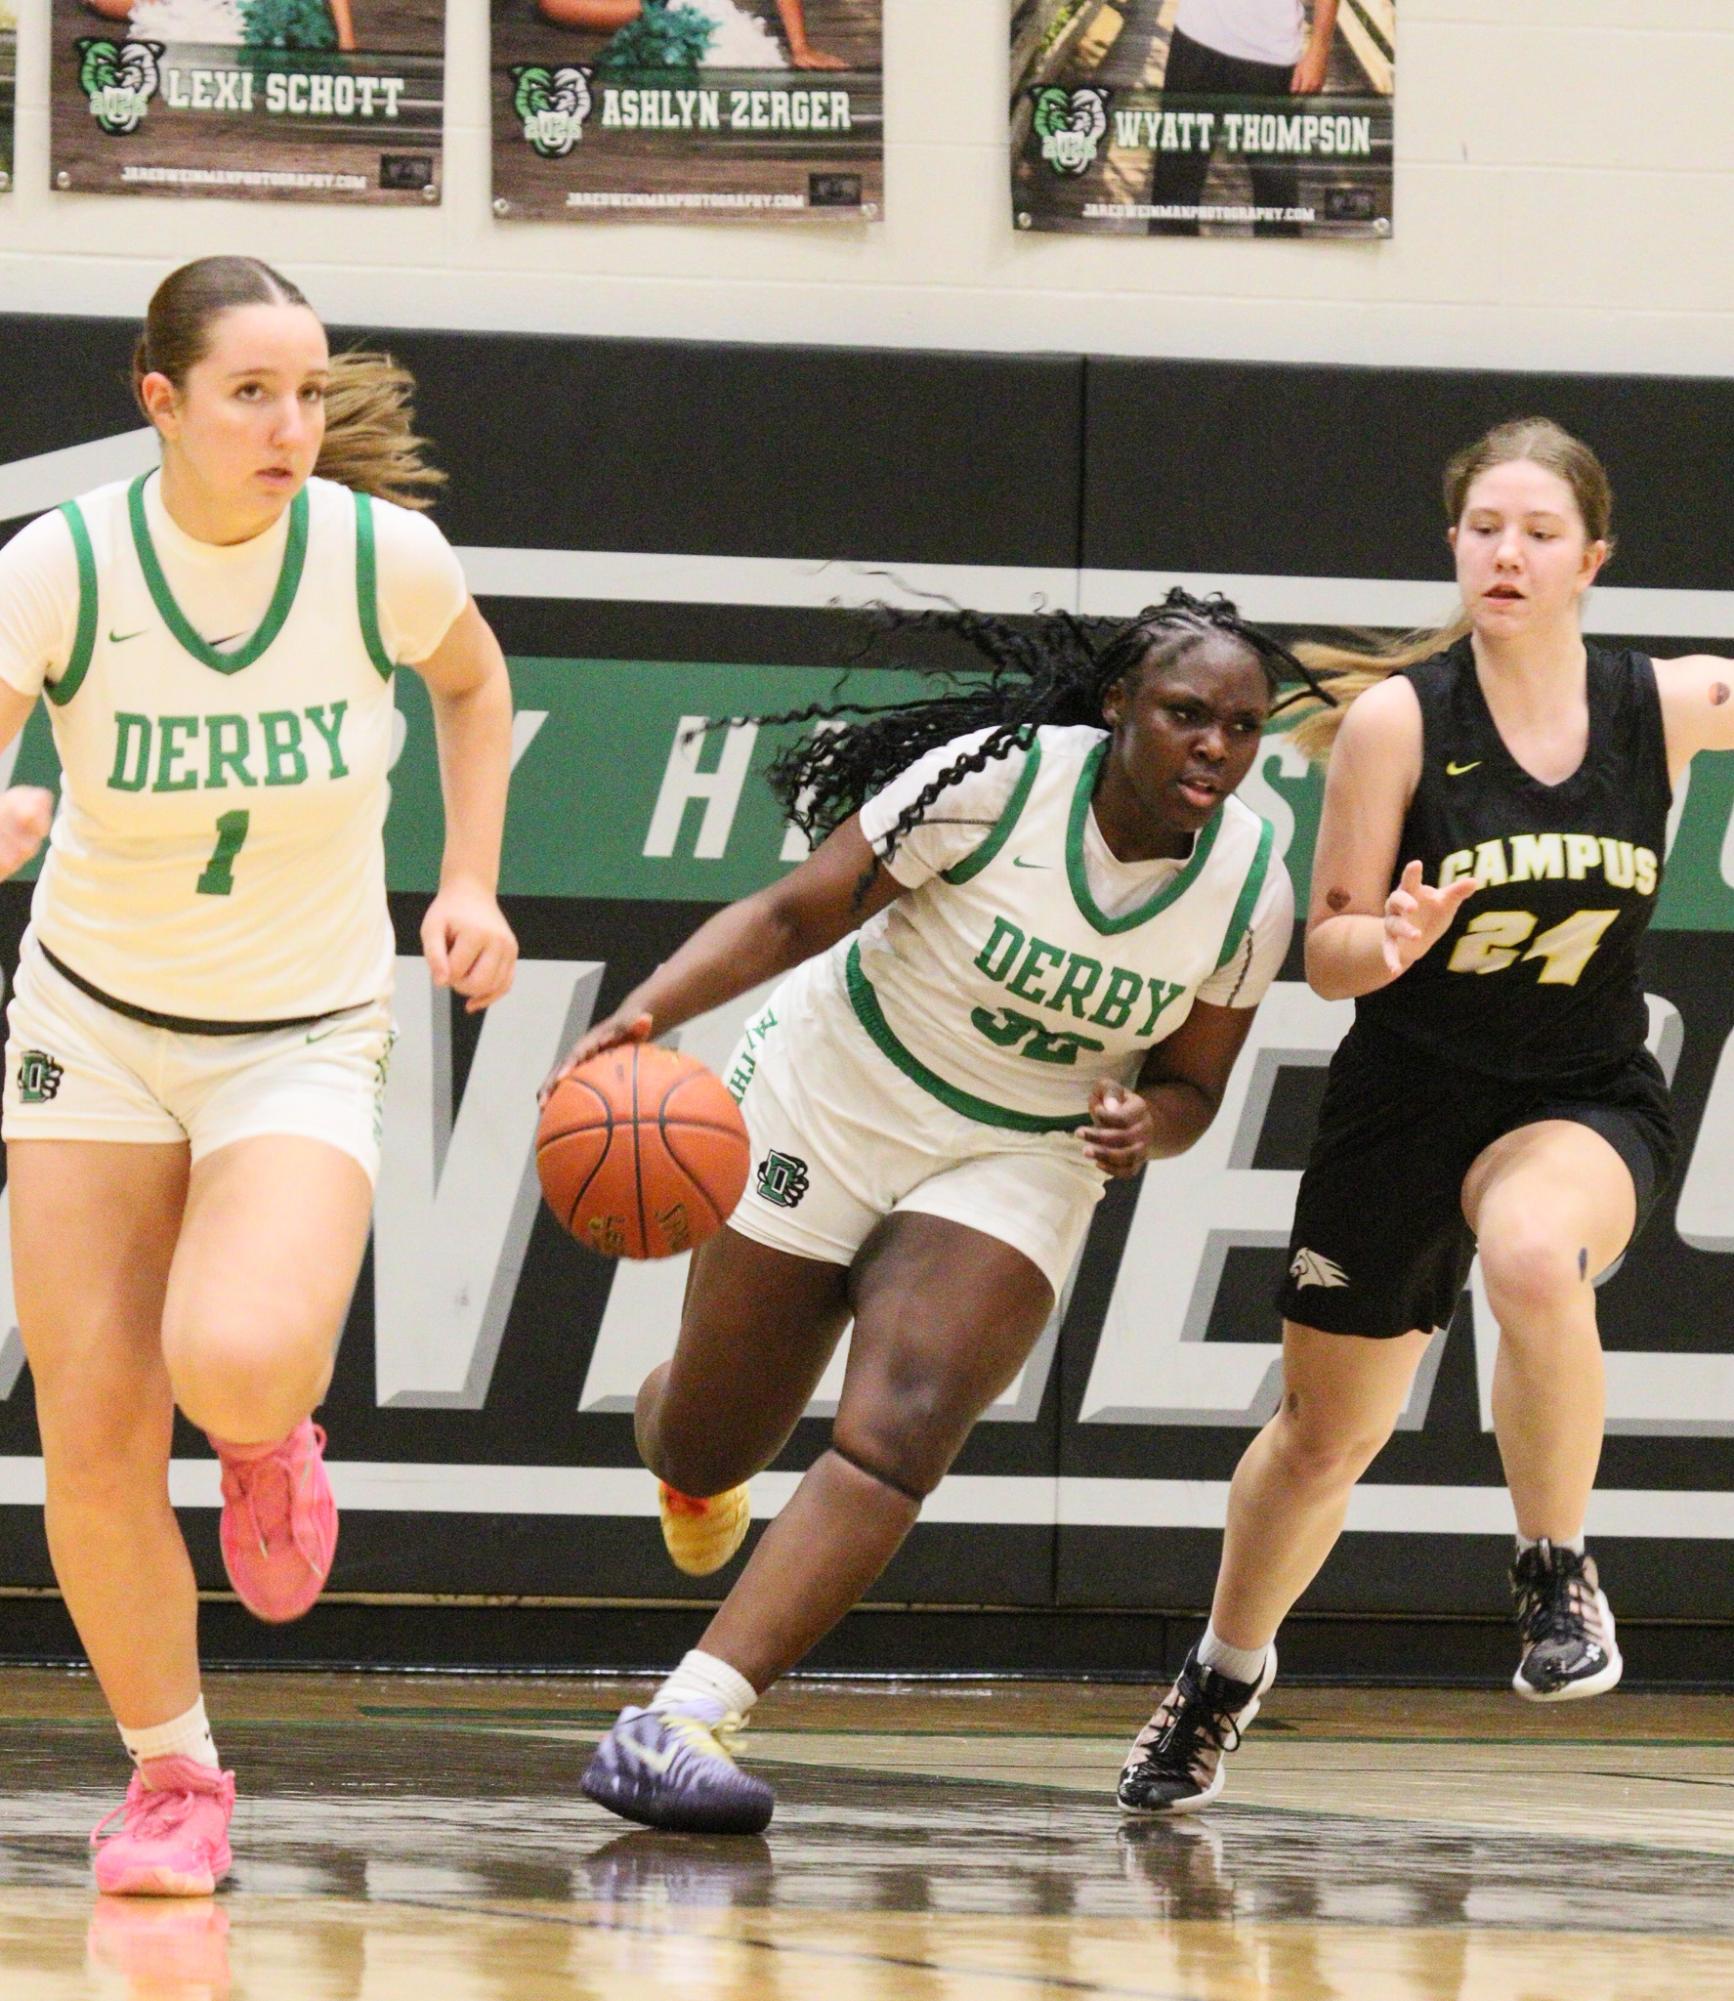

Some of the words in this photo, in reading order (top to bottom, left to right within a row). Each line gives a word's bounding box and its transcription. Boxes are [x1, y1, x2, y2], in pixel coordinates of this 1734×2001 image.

[168, 70, 253, 110] LEXI
[266, 72, 404, 118] SCHOTT
[602, 89, 719, 128] ASHLYN
[731, 91, 851, 129] ZERGER
[1114, 111, 1214, 150] WYATT
[1223, 114, 1371, 153] THOMPSON
[107, 700, 350, 793] DERBY
[196, 810, 250, 896] 1
[1438, 833, 1658, 896] CAMPUS
[973, 915, 1187, 1037] DERBY
[1447, 909, 1621, 986] 24
